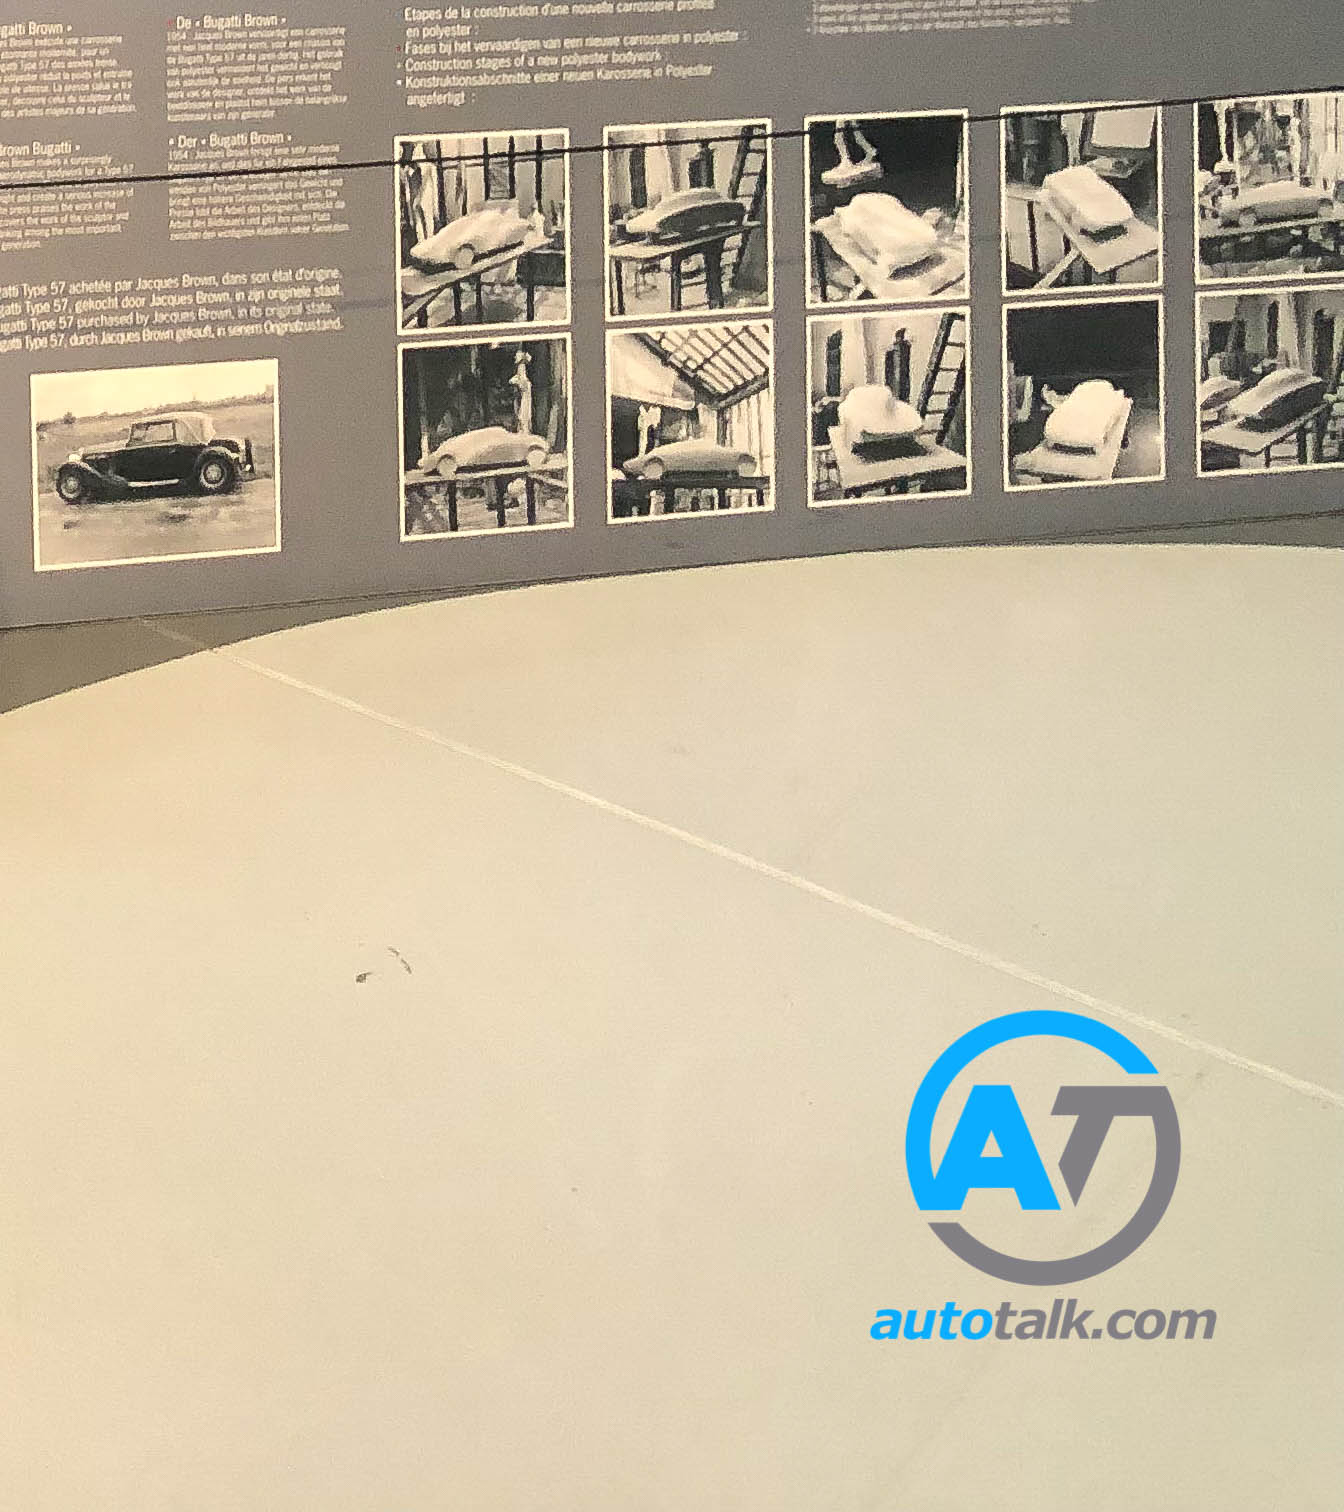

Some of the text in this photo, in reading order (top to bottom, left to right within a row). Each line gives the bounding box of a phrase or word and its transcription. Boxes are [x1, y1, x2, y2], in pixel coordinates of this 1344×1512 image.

[444, 5, 459, 19] de
[461, 5, 471, 19] la
[473, 4, 539, 18] construction
[541, 3, 570, 16] d'une
[28, 21, 63, 35] Brown
[176, 14, 278, 30] De Bugatti Brown
[406, 24, 472, 39] en polyester
[405, 41, 437, 55] Fases
[439, 41, 452, 56] bij
[454, 41, 471, 53] het
[473, 38, 541, 53] vervaardigen
[543, 39, 561, 49] van
[405, 49, 662, 72] Construction stages of a new polyester bodywork
[405, 71, 531, 89] Konstruktionsabschnitte
[665, 64, 714, 78] Polyester
[406, 91, 465, 108] angefertigt
[32, 141, 72, 157] Bugatti
[178, 131, 284, 149] Der Bugatti Brown
[21, 283, 48, 299] Type
[50, 281, 66, 295] 57
[68, 280, 112, 295] achetée
[114, 279, 133, 293] par
[135, 277, 179, 292] Jacques
[182, 274, 219, 288] Brown,
[222, 272, 248, 286] dans
[250, 272, 270, 284] son
[272, 268, 293, 282] état
[24, 301, 51, 316] Type
[53, 299, 72, 313] 57,
[74, 296, 119, 314] gekocht
[121, 295, 146, 309] door
[150, 294, 193, 308] Jacques
[235, 290, 245, 301] in
[248, 288, 264, 303] zijn
[30, 318, 56, 334] Type
[59, 316, 74, 330] 57
[77, 313, 133, 330] purchased
[135, 312, 150, 326] by
[154, 311, 195, 325] Jacques
[237, 307, 248, 319] in
[249, 306, 263, 318] its
[265, 303, 303, 319] original
[24, 336, 48, 352] Type
[70, 332, 98, 347] durch
[101, 331, 140, 348] Jacques
[142, 328, 174, 342] Brown
